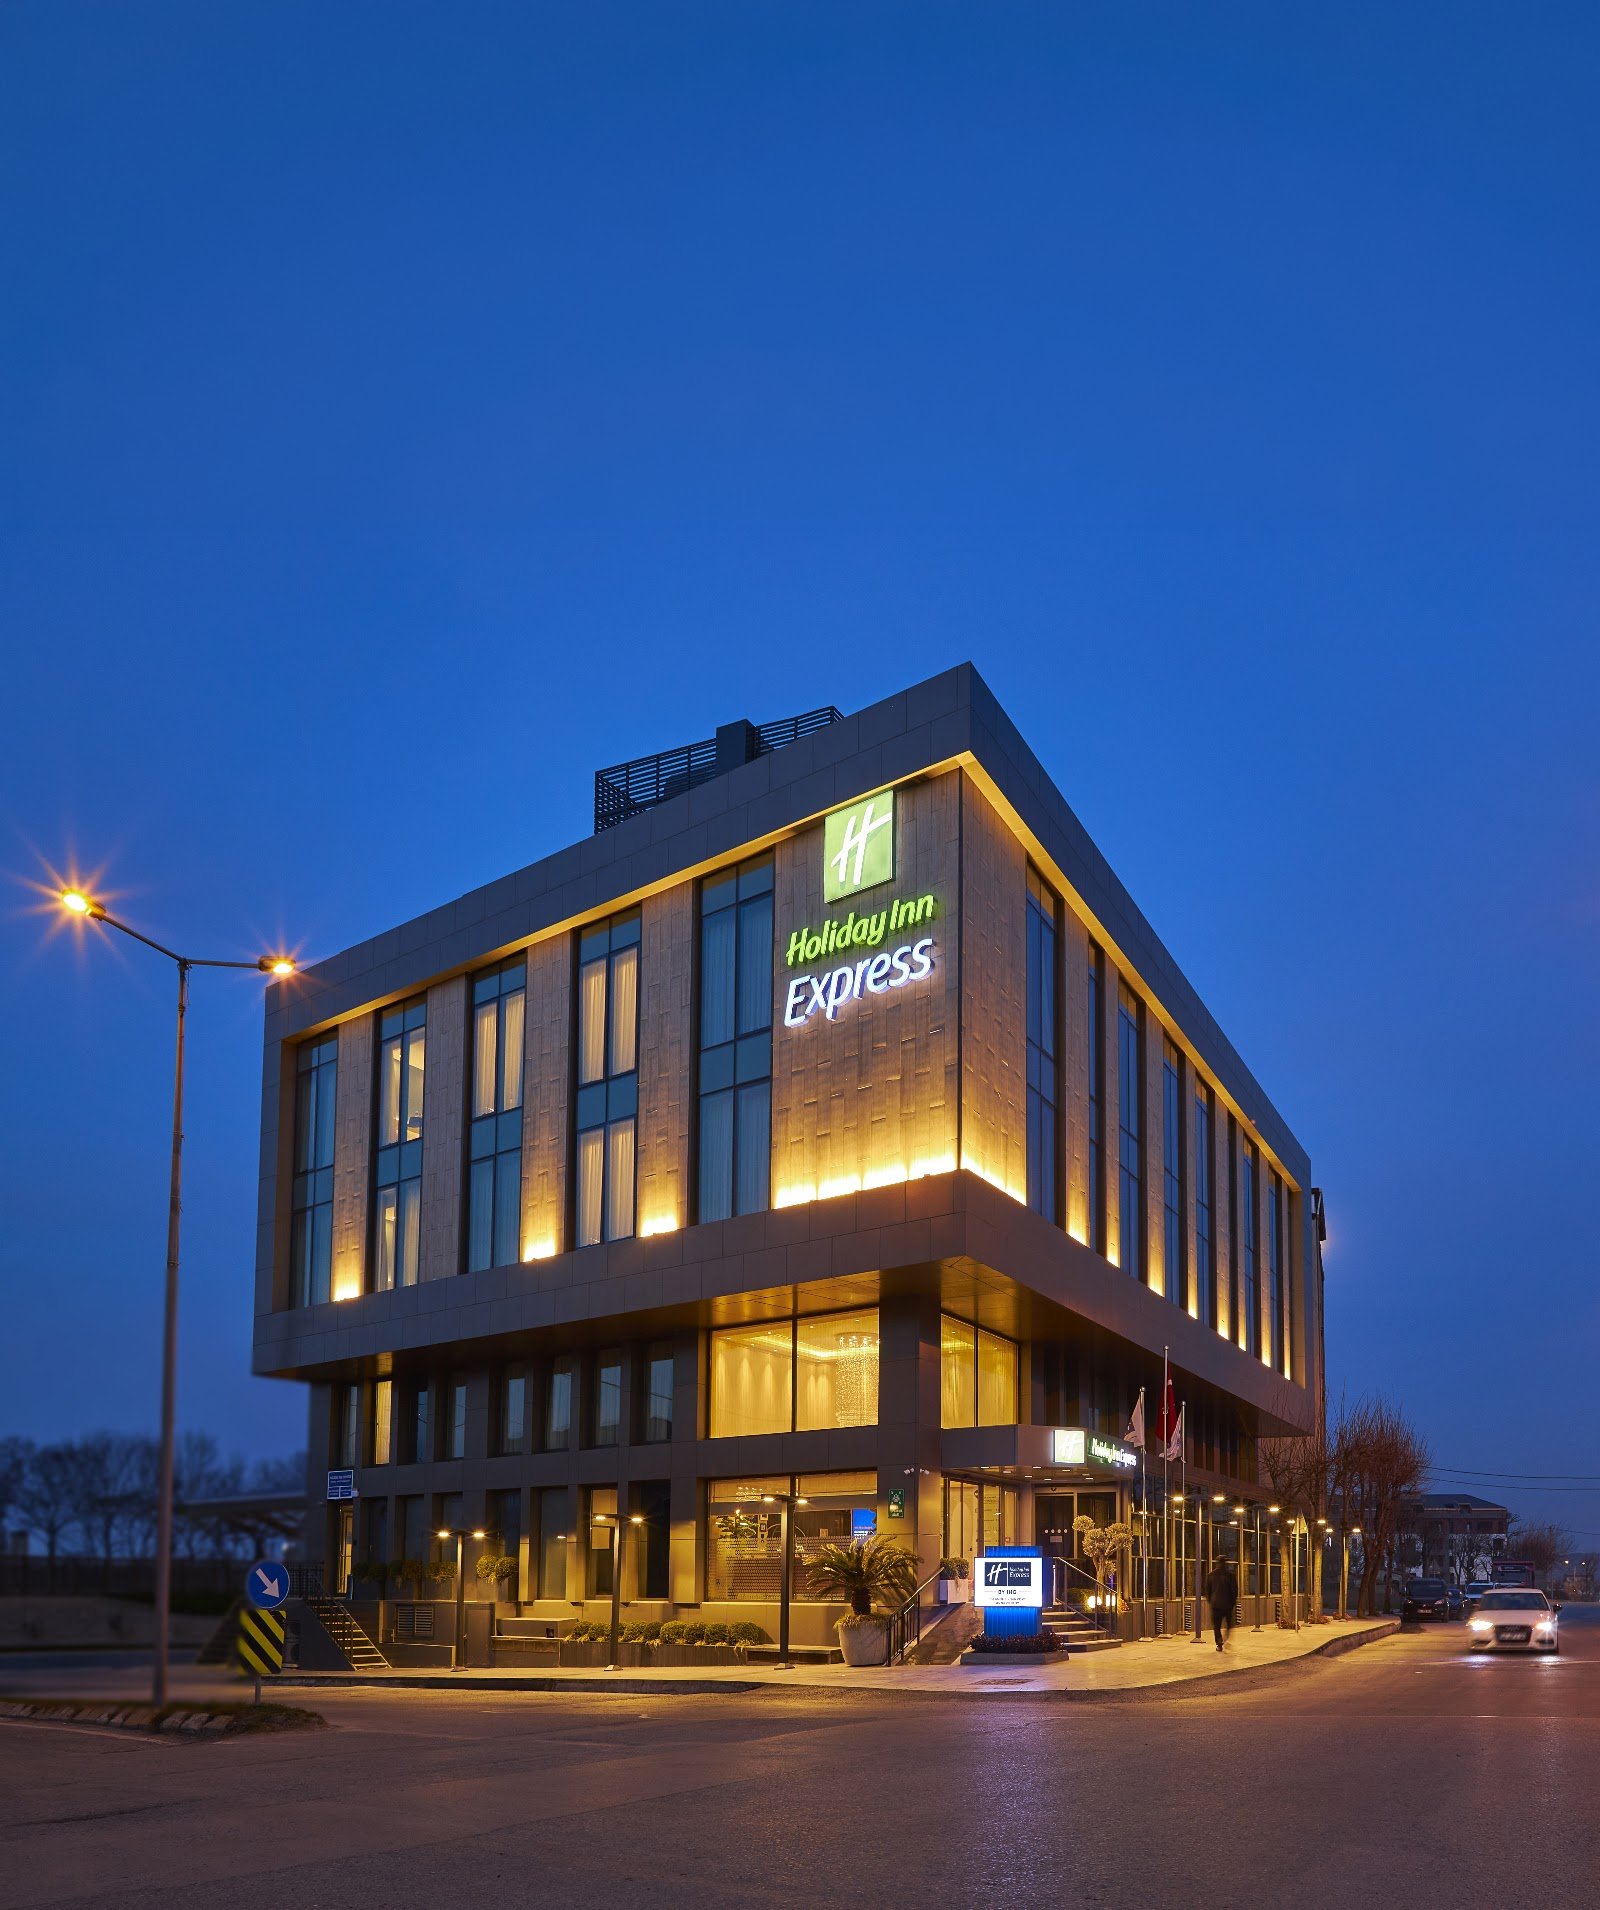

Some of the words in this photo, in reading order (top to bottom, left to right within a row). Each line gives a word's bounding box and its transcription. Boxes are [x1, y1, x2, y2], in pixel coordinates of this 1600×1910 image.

[786, 911, 887, 966] Holiday
[890, 894, 934, 931] Inn
[784, 938, 934, 1028] Express
